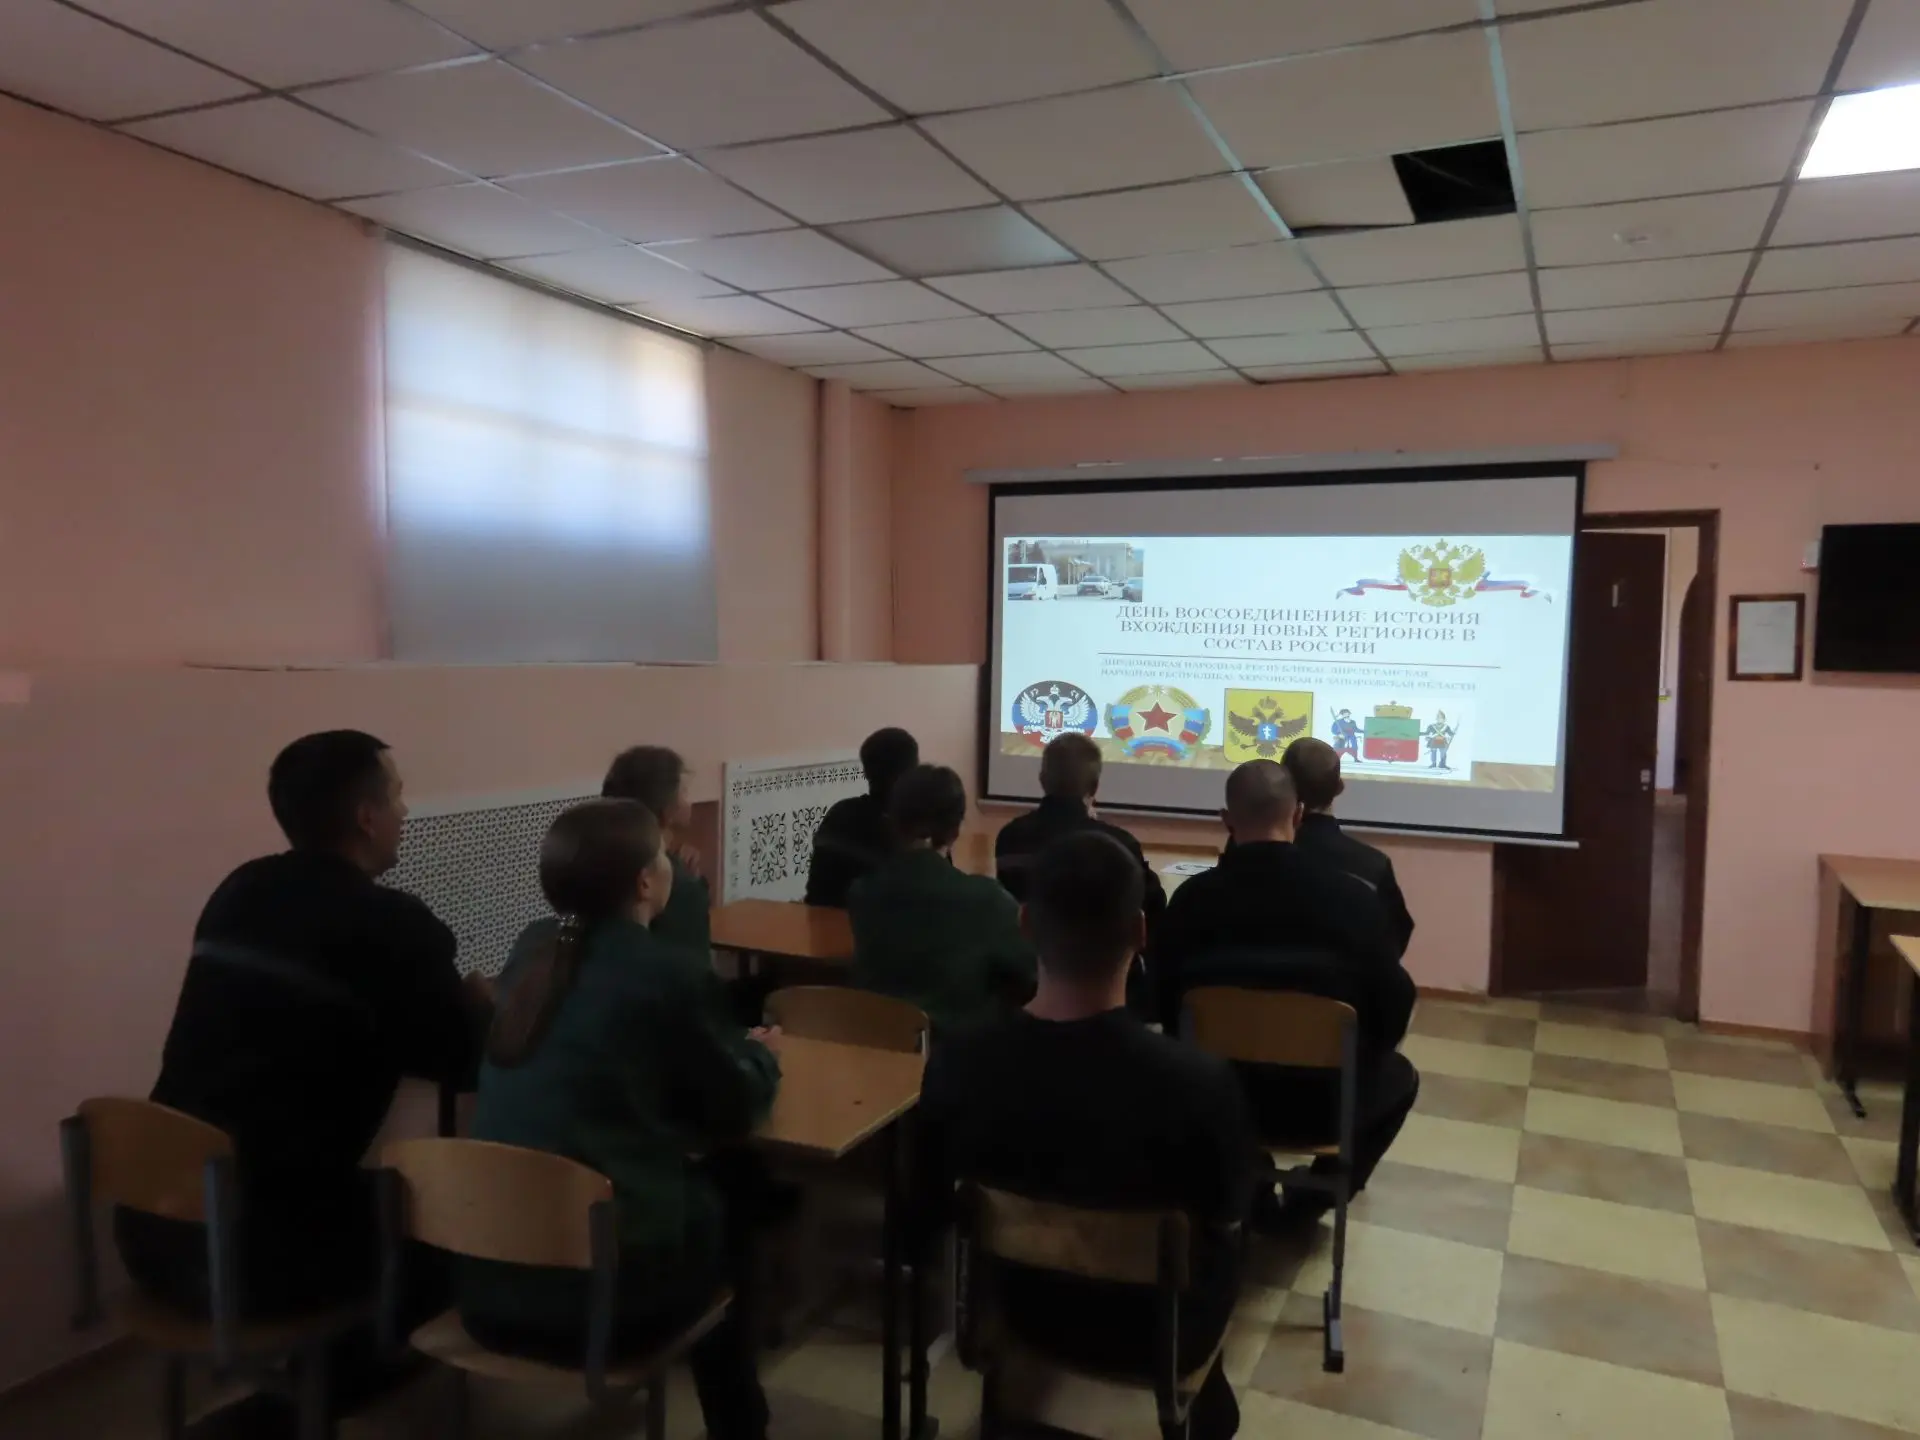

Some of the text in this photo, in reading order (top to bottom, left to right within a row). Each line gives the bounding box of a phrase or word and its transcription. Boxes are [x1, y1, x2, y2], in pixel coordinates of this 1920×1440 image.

[1115, 606, 1169, 618] ДЕНЬ
[1374, 610, 1480, 625] ИСТОРИЯ
[1120, 620, 1476, 641] ВХОЖДЕНИЯ НОВЫХ РЕГИОНОВ В
[1203, 637, 1376, 654] СОСТАВ РОССИИ
